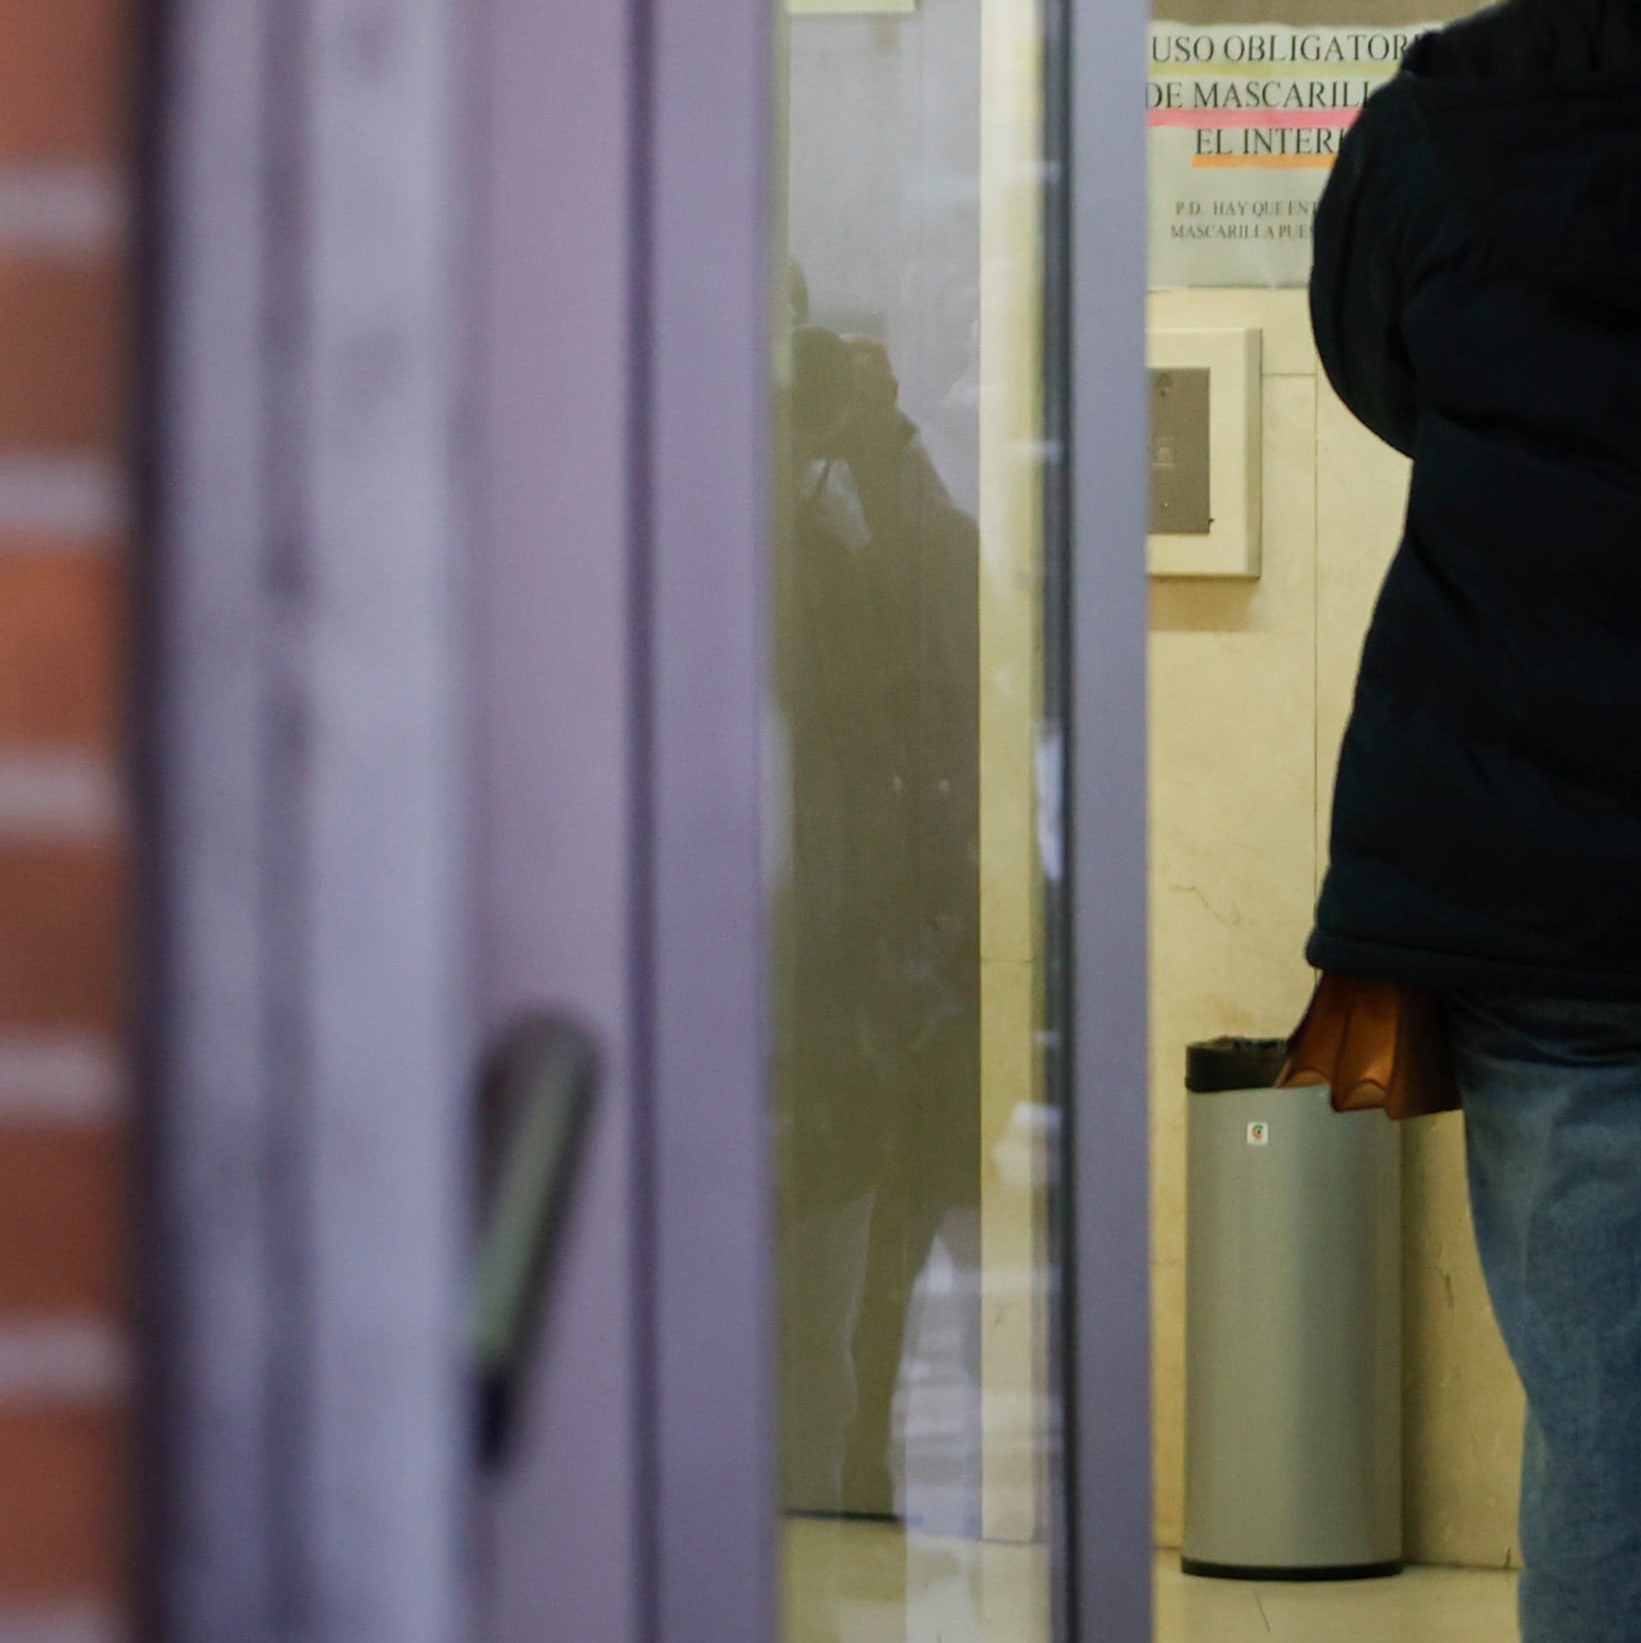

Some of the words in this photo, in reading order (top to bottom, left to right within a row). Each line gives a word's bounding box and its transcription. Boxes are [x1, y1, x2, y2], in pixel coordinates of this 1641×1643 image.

[1152, 34, 1215, 62] USO
[1145, 82, 1183, 108] DE
[1196, 128, 1232, 155] EL
[1213, 200, 1248, 216] HAY
